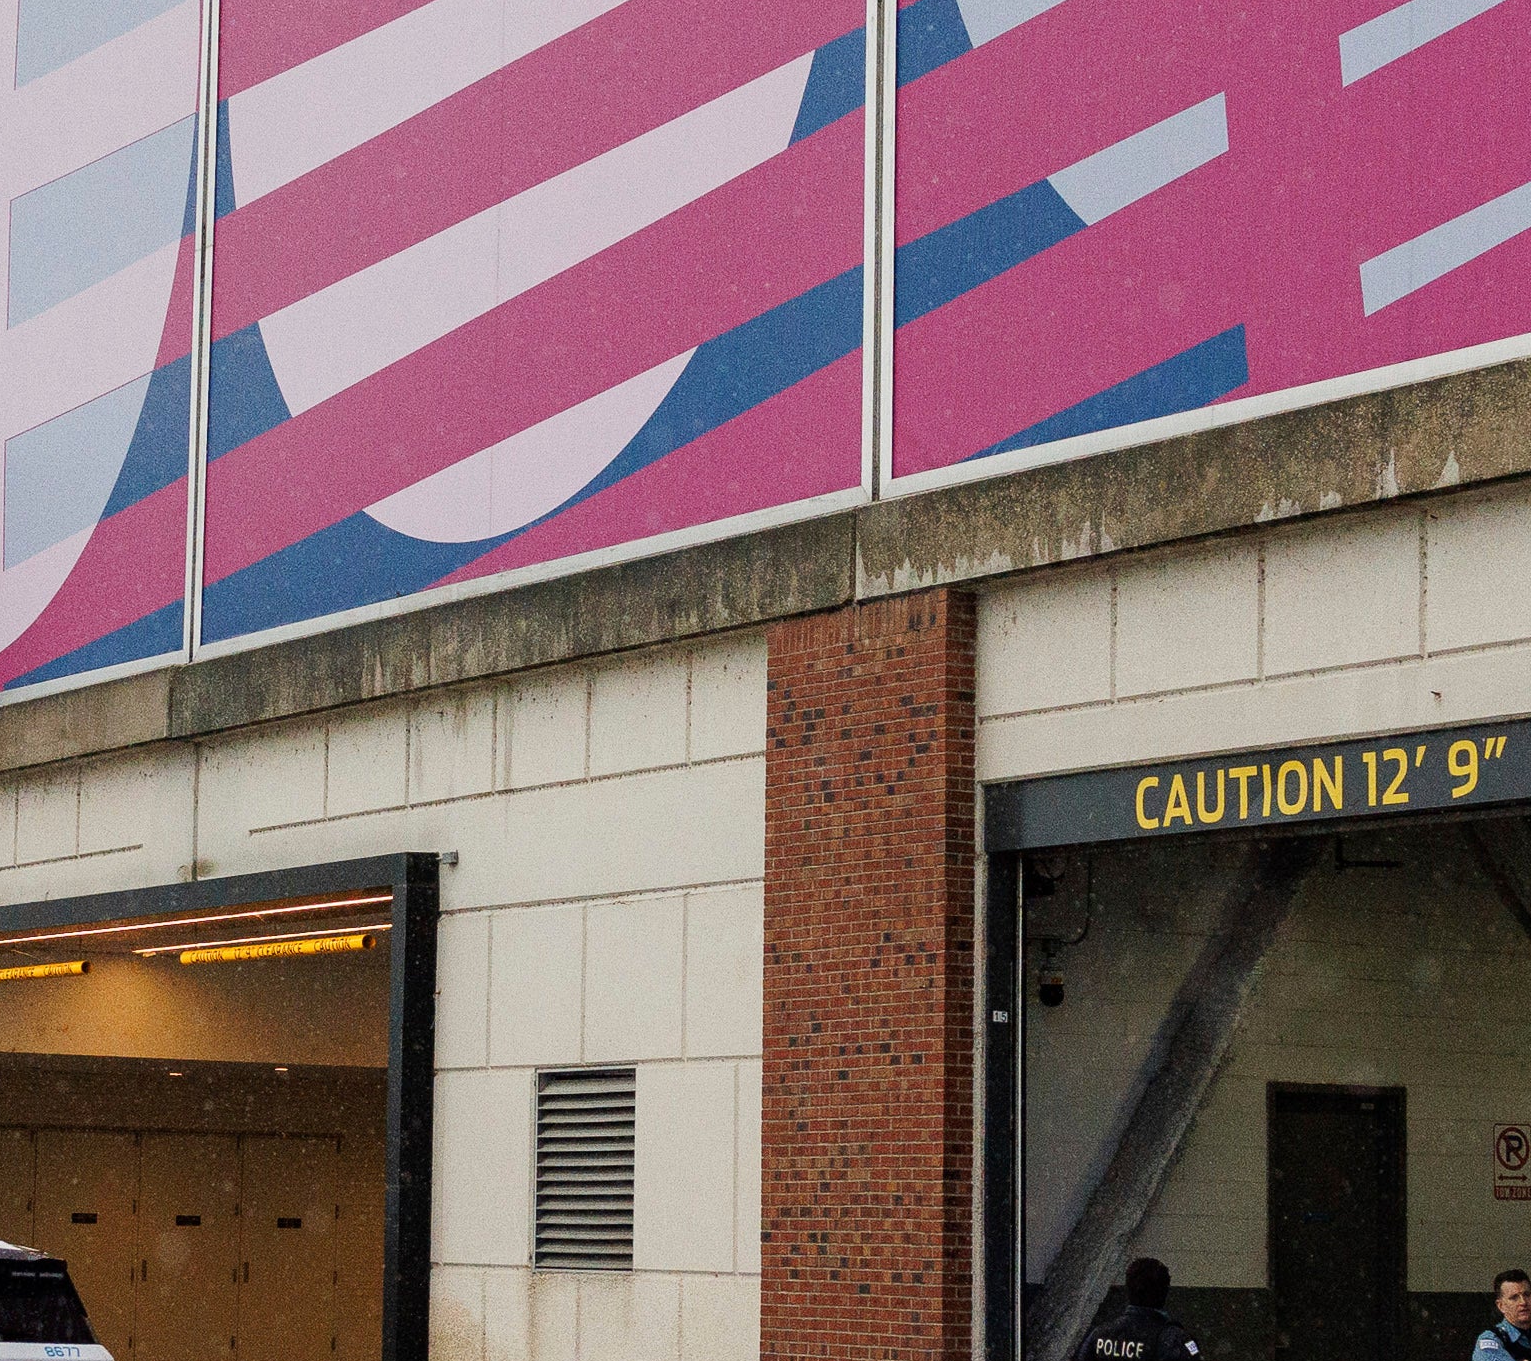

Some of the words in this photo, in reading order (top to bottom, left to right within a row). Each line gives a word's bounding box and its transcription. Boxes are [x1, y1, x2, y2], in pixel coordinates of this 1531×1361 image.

[1135, 755, 1343, 830] CAUTION
[1361, 743, 1428, 807] 12'
[1447, 735, 1508, 800] 9"
[44, 1346, 81, 1358] 8677
[1096, 1339, 1144, 1358] POLICE
